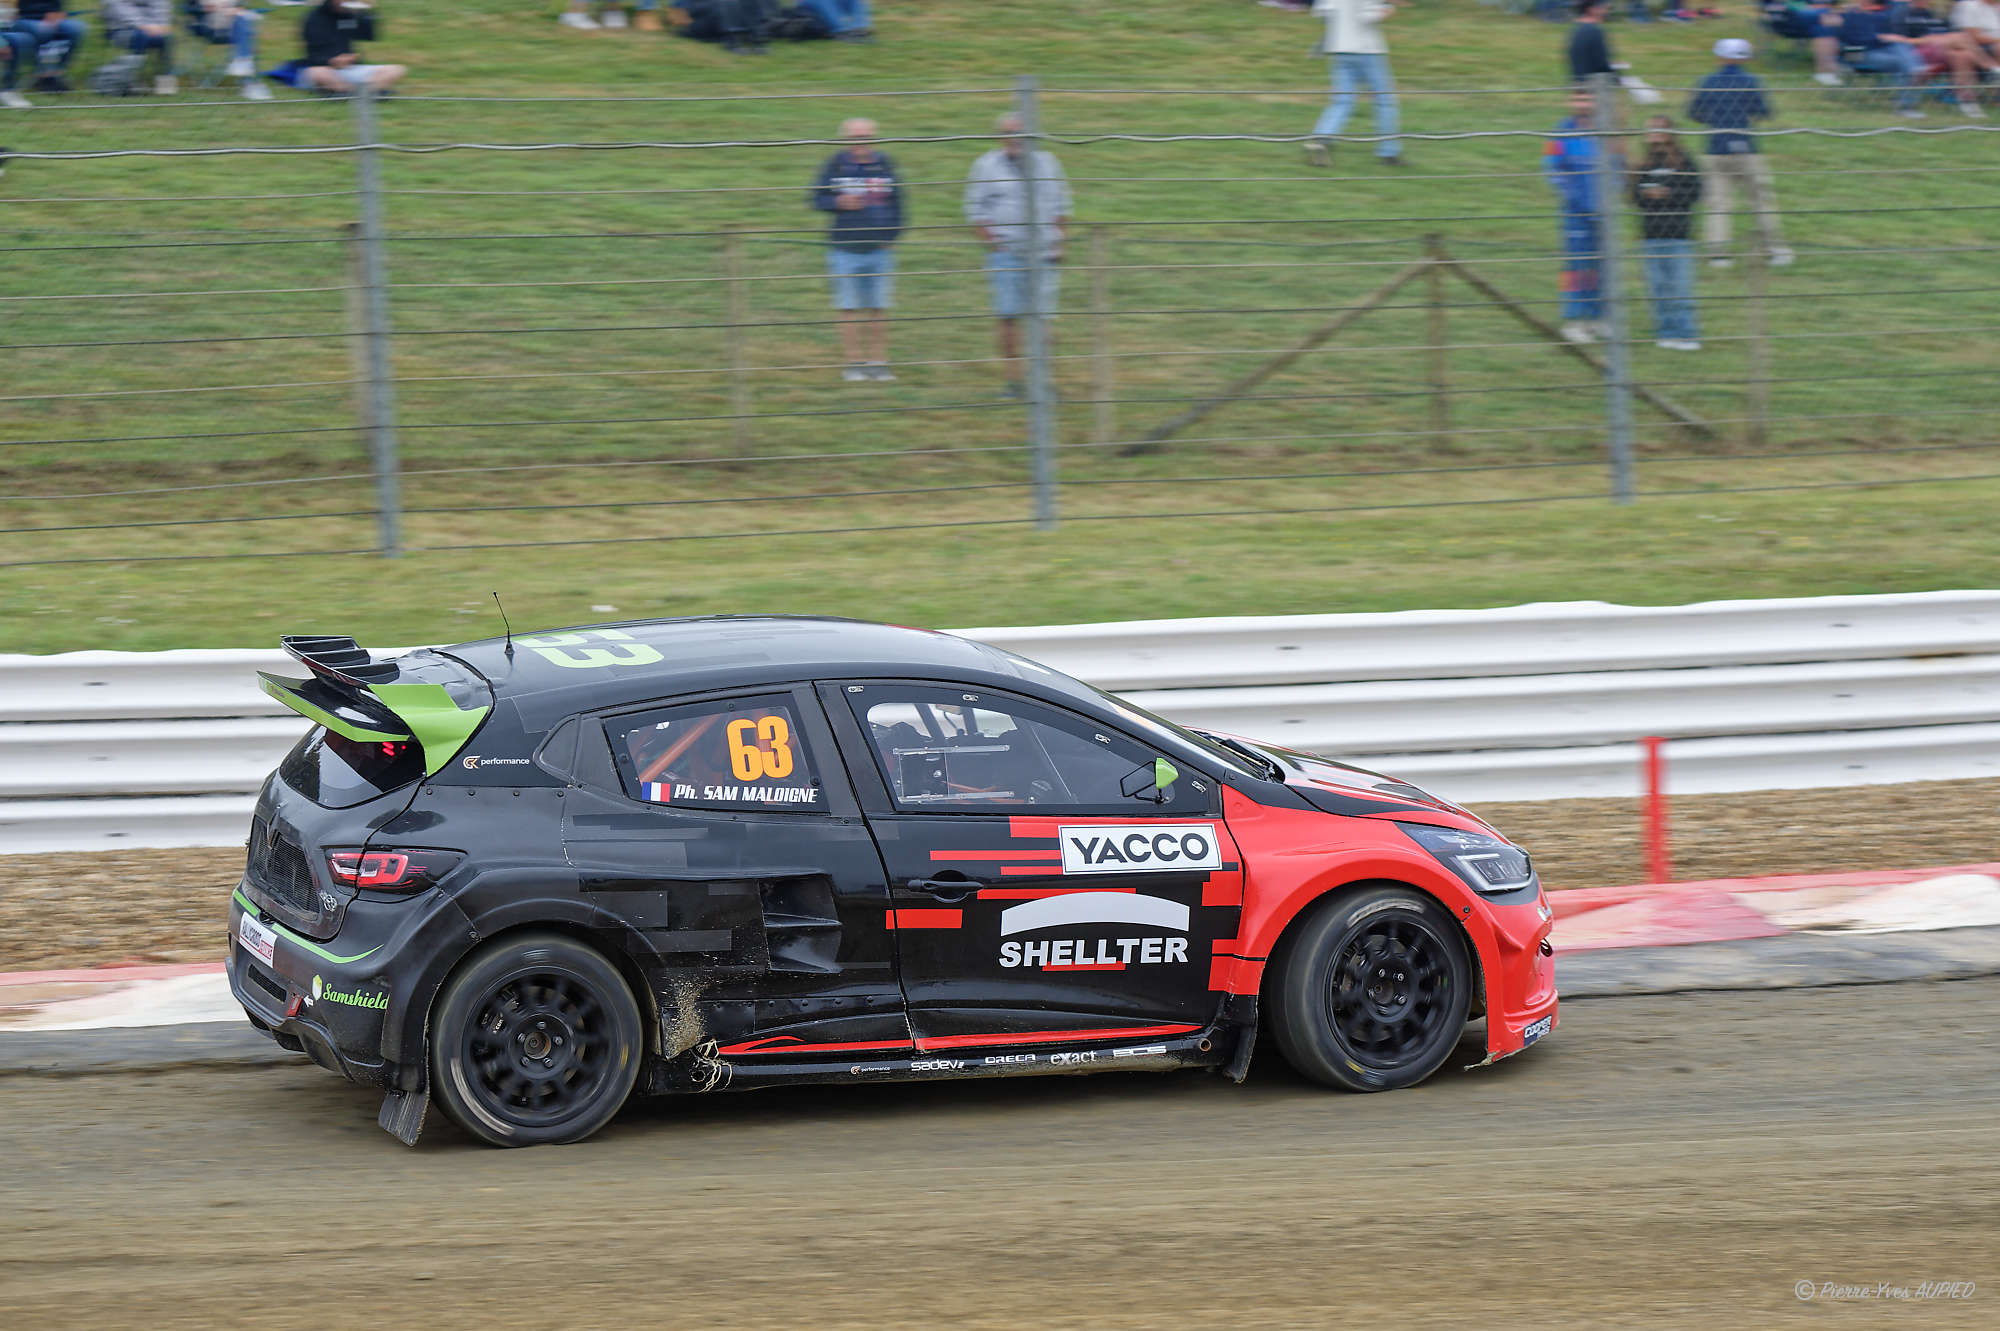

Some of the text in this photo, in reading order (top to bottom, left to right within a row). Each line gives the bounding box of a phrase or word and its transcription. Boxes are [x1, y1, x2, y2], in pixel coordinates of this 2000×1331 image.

[727, 716, 793, 781] 63
[480, 757, 530, 766] performance
[674, 784, 818, 802] Ph. SAM MALOIGNE
[1071, 833, 1209, 864] YACCO
[999, 937, 1189, 968] SHELLTER
[323, 983, 390, 1010] Samshield
[911, 1060, 957, 1071] sadev
[985, 1054, 1036, 1064] ORECA
